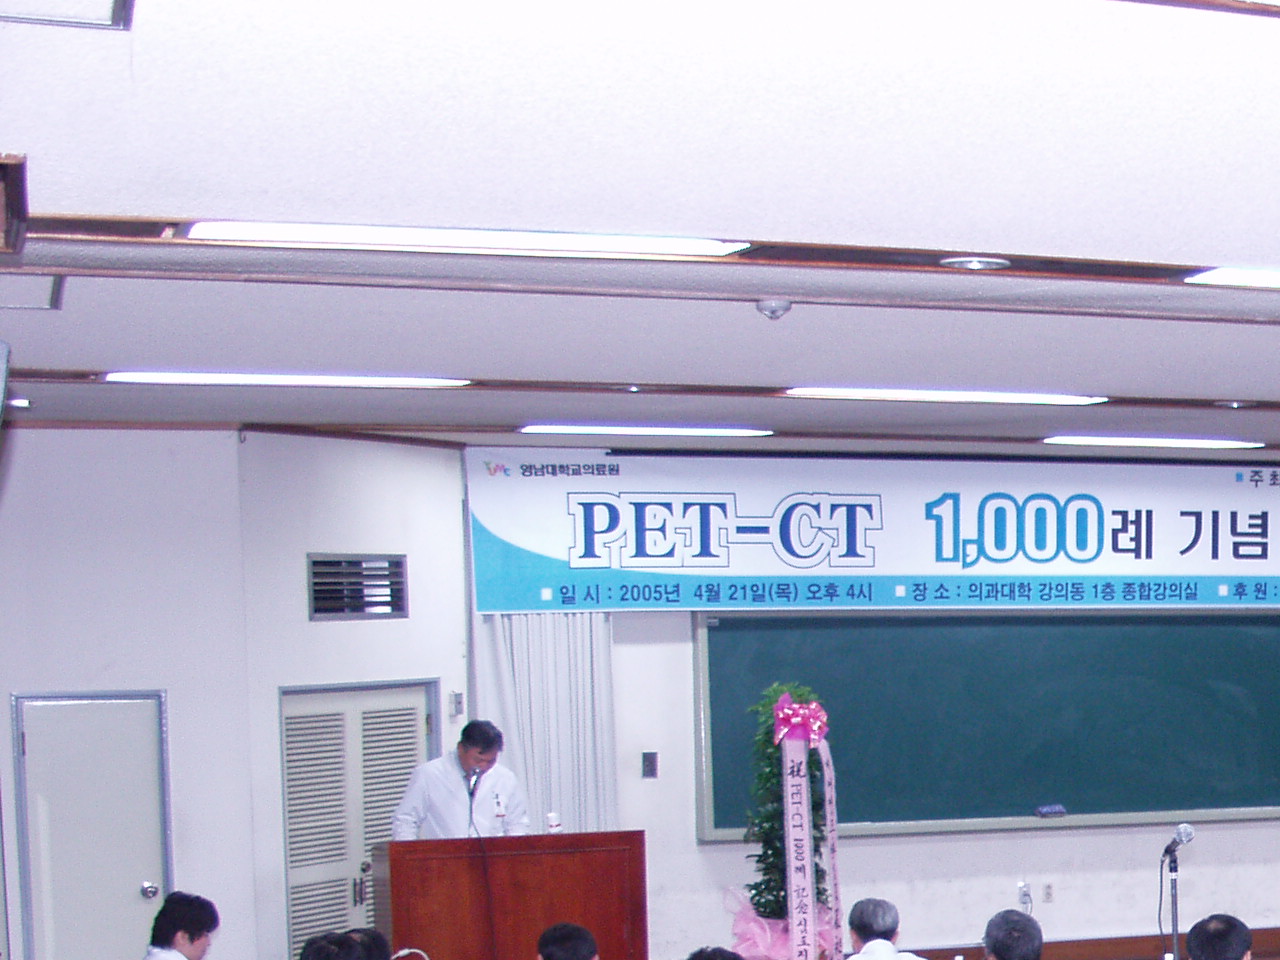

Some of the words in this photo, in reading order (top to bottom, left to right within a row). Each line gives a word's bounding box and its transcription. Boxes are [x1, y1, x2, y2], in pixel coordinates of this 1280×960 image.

[520, 463, 620, 477] 영남대학교의료원
[567, 492, 883, 569] PET-CT
[1179, 510, 1270, 561] 기념
[620, 584, 681, 602] 2005년
[693, 584, 721, 602] 4월
[728, 583, 799, 604] 21일(목)
[806, 583, 840, 602] 오후
[846, 583, 873, 602] 4시
[968, 582, 1032, 601] 의과대학
[1038, 582, 1085, 601] 강의동
[1092, 582, 1115, 601] 1층
[1121, 582, 1199, 601] 종합강의실
